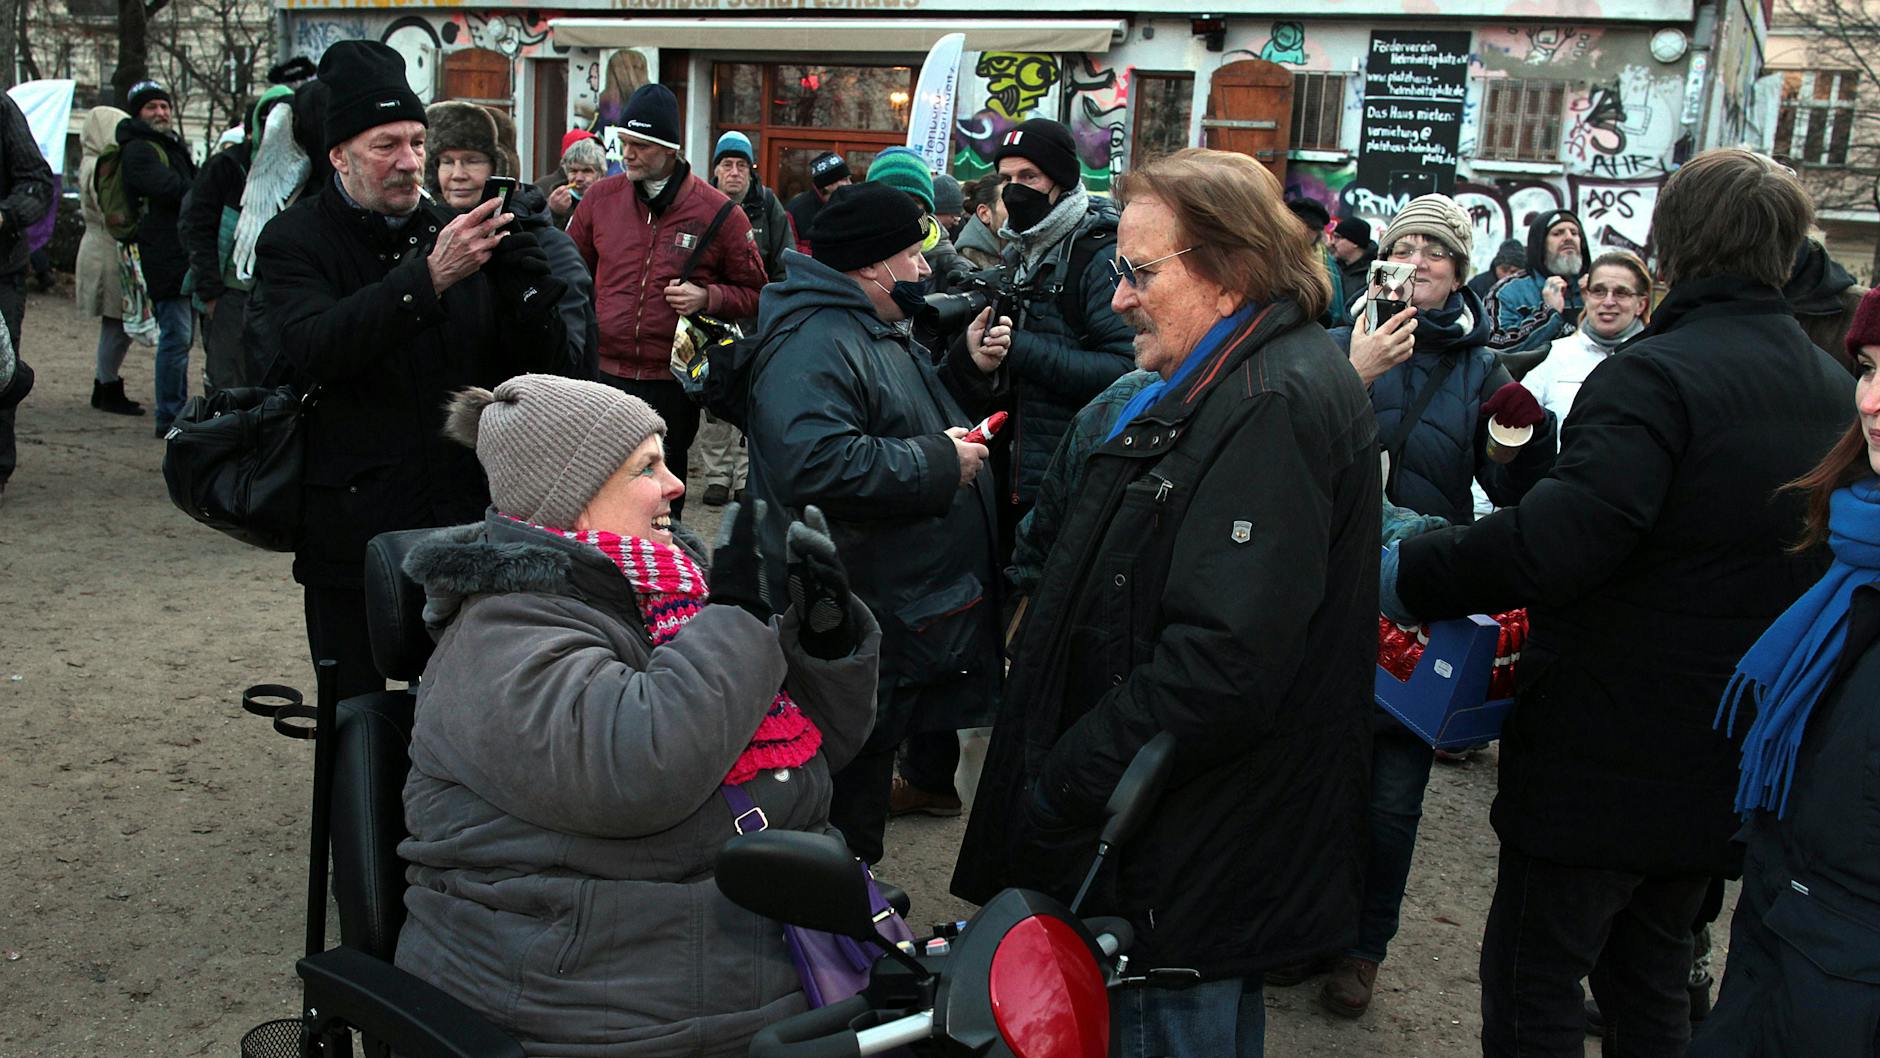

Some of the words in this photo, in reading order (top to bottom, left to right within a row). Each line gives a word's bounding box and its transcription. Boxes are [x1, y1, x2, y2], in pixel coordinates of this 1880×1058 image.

[1373, 38, 1438, 53] Förderverein
[1367, 105, 1388, 119] Das
[1389, 105, 1415, 120] Haus
[1416, 107, 1456, 122] mieten:
